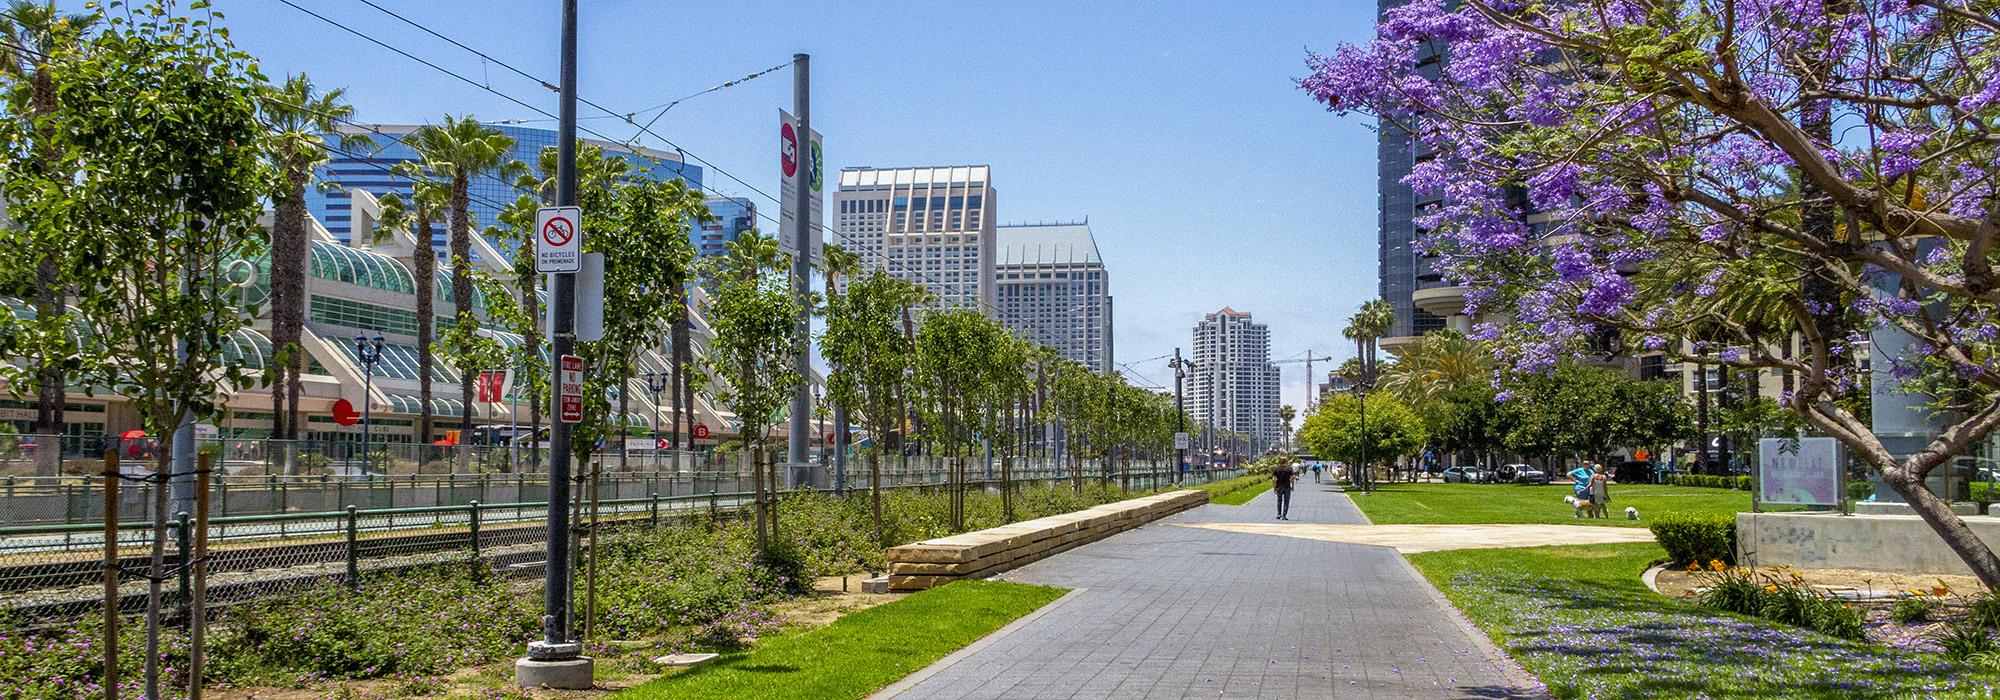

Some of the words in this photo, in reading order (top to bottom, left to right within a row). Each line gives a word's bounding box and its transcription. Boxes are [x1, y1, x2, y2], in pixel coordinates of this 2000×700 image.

[569, 371, 575, 382] NO
[563, 383, 581, 394] PARKING
[699, 429, 706, 438] B
